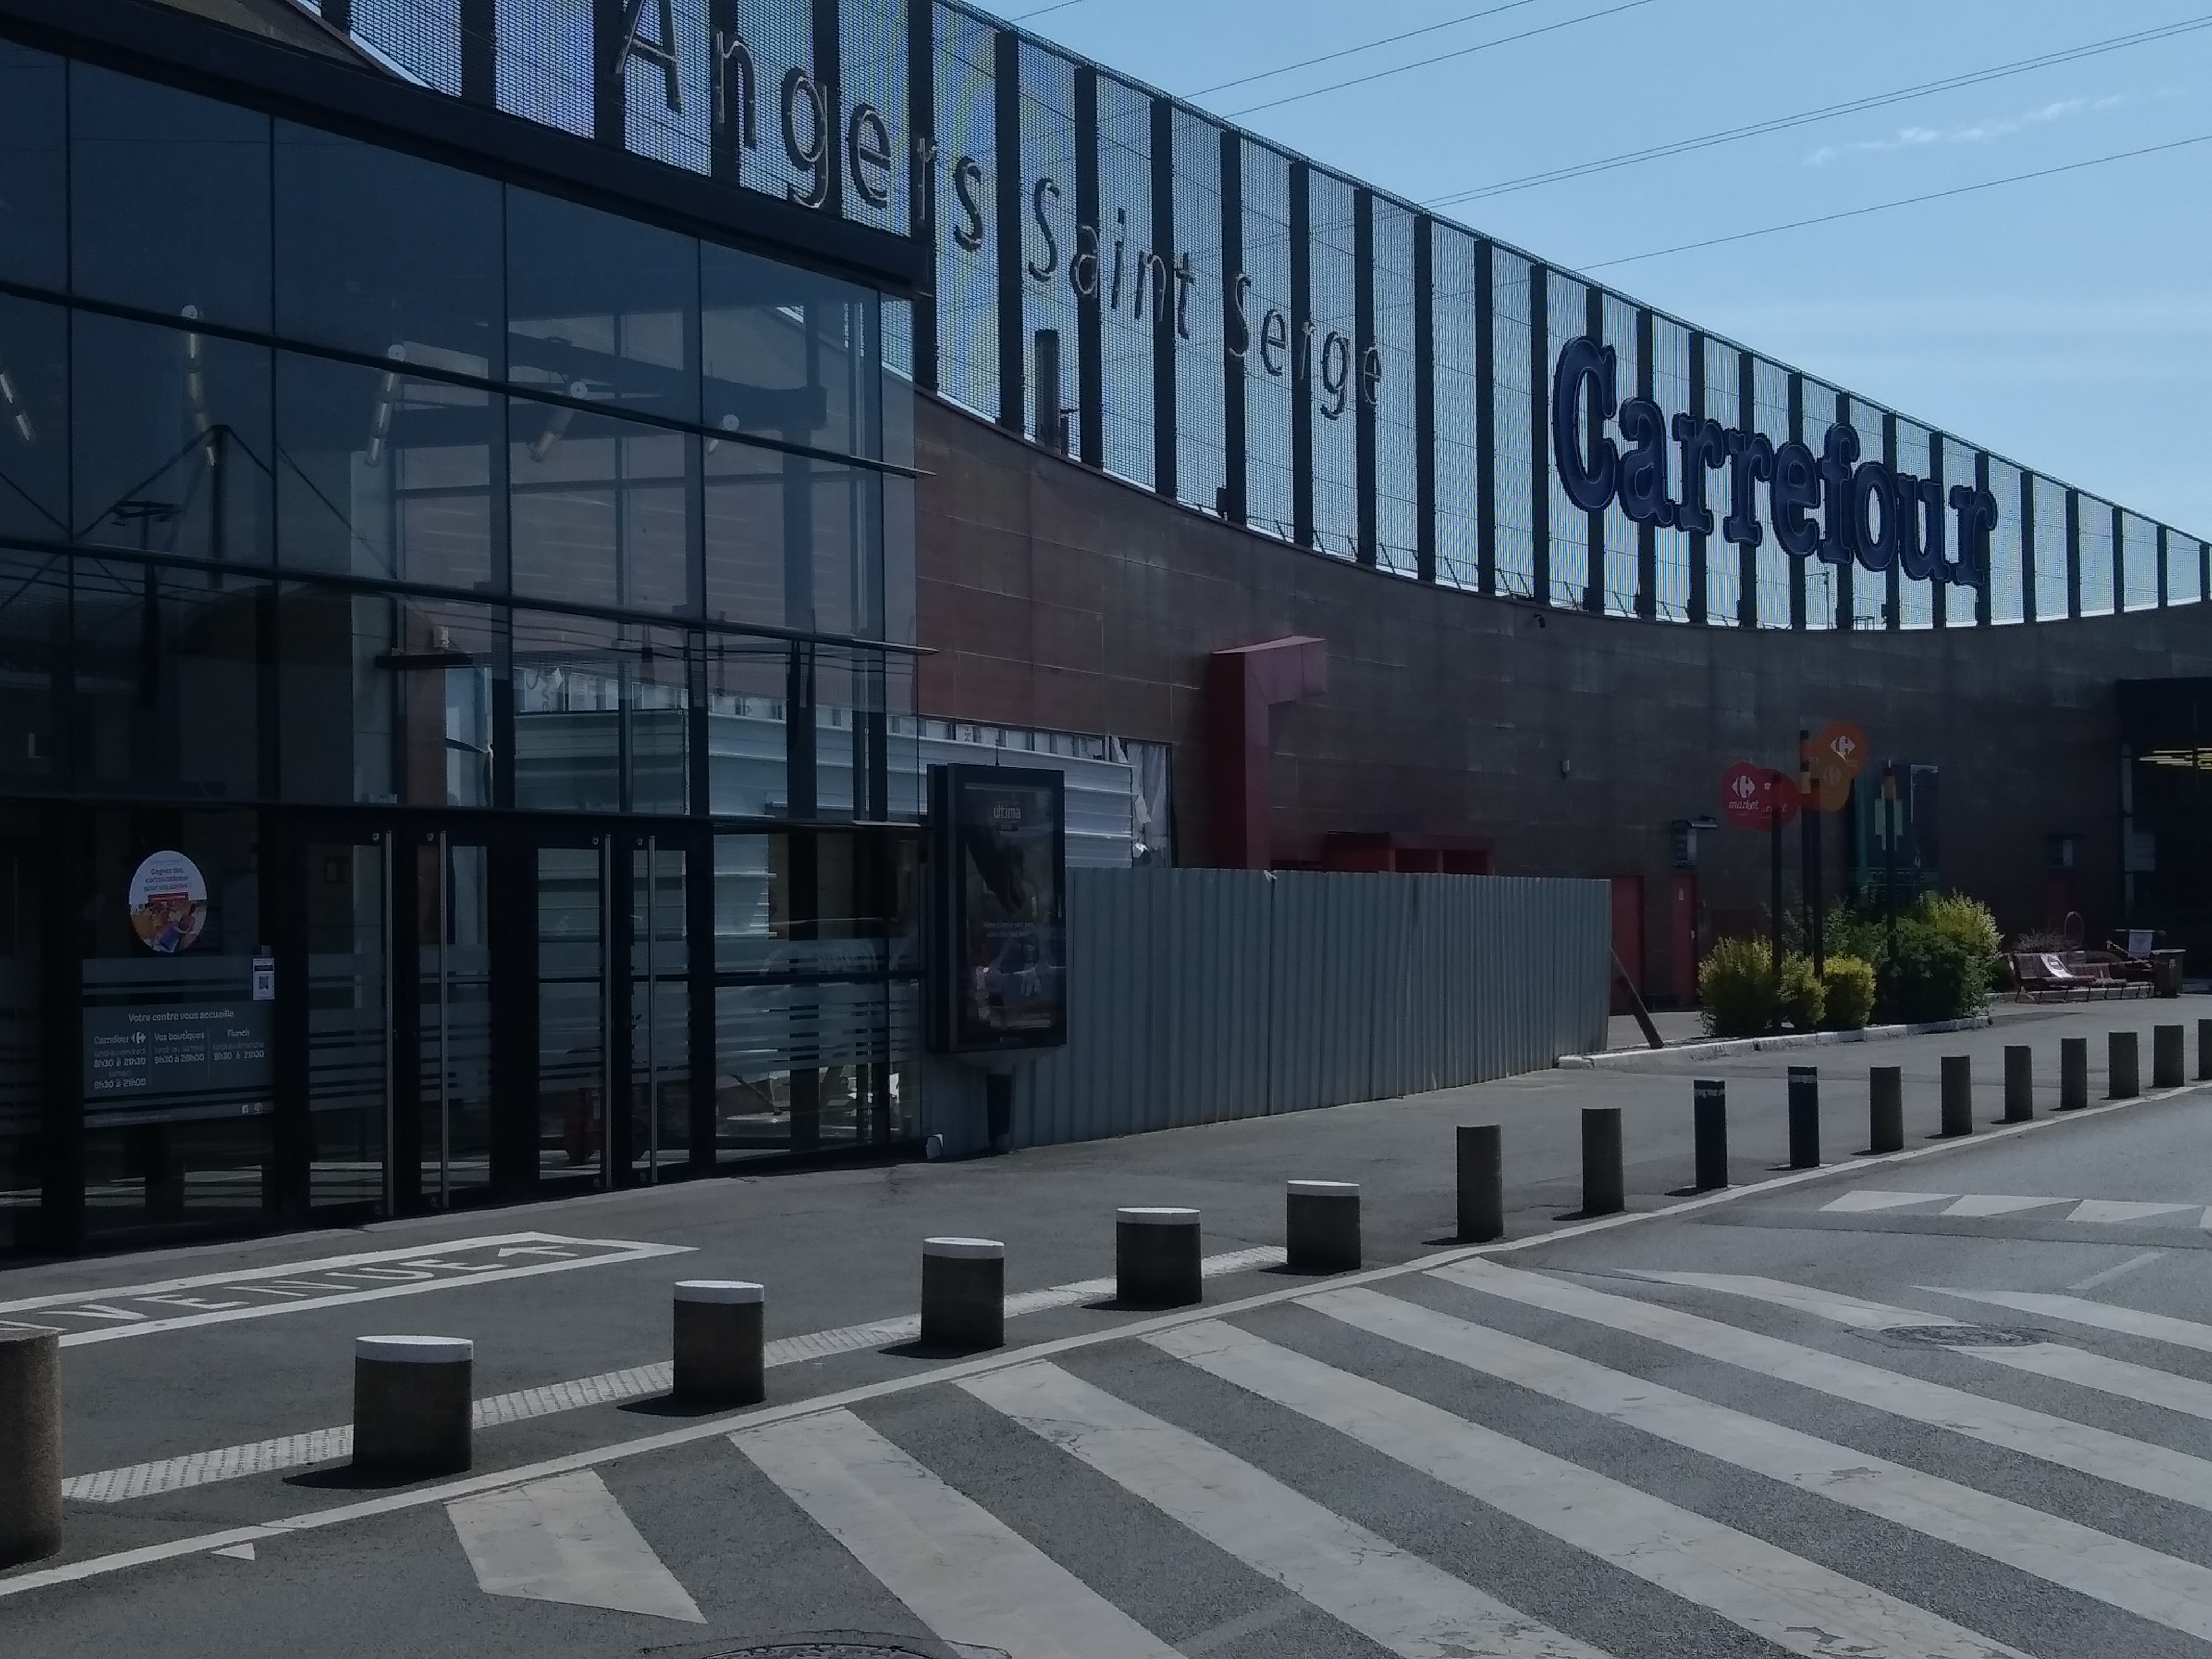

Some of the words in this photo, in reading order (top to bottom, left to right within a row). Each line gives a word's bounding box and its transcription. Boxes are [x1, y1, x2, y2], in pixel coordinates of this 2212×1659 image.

[611, 0, 983, 252] Angers
[1028, 177, 1196, 340] Saint
[1229, 272, 1382, 419] Serge
[1553, 336, 1998, 586] Carrefour
[1728, 800, 1759, 810] market
[128, 1013, 150, 1023] Votre
[152, 1012, 179, 1021] centre
[199, 1009, 234, 1019] accueille
[168, 1031, 205, 1041] boutiques
